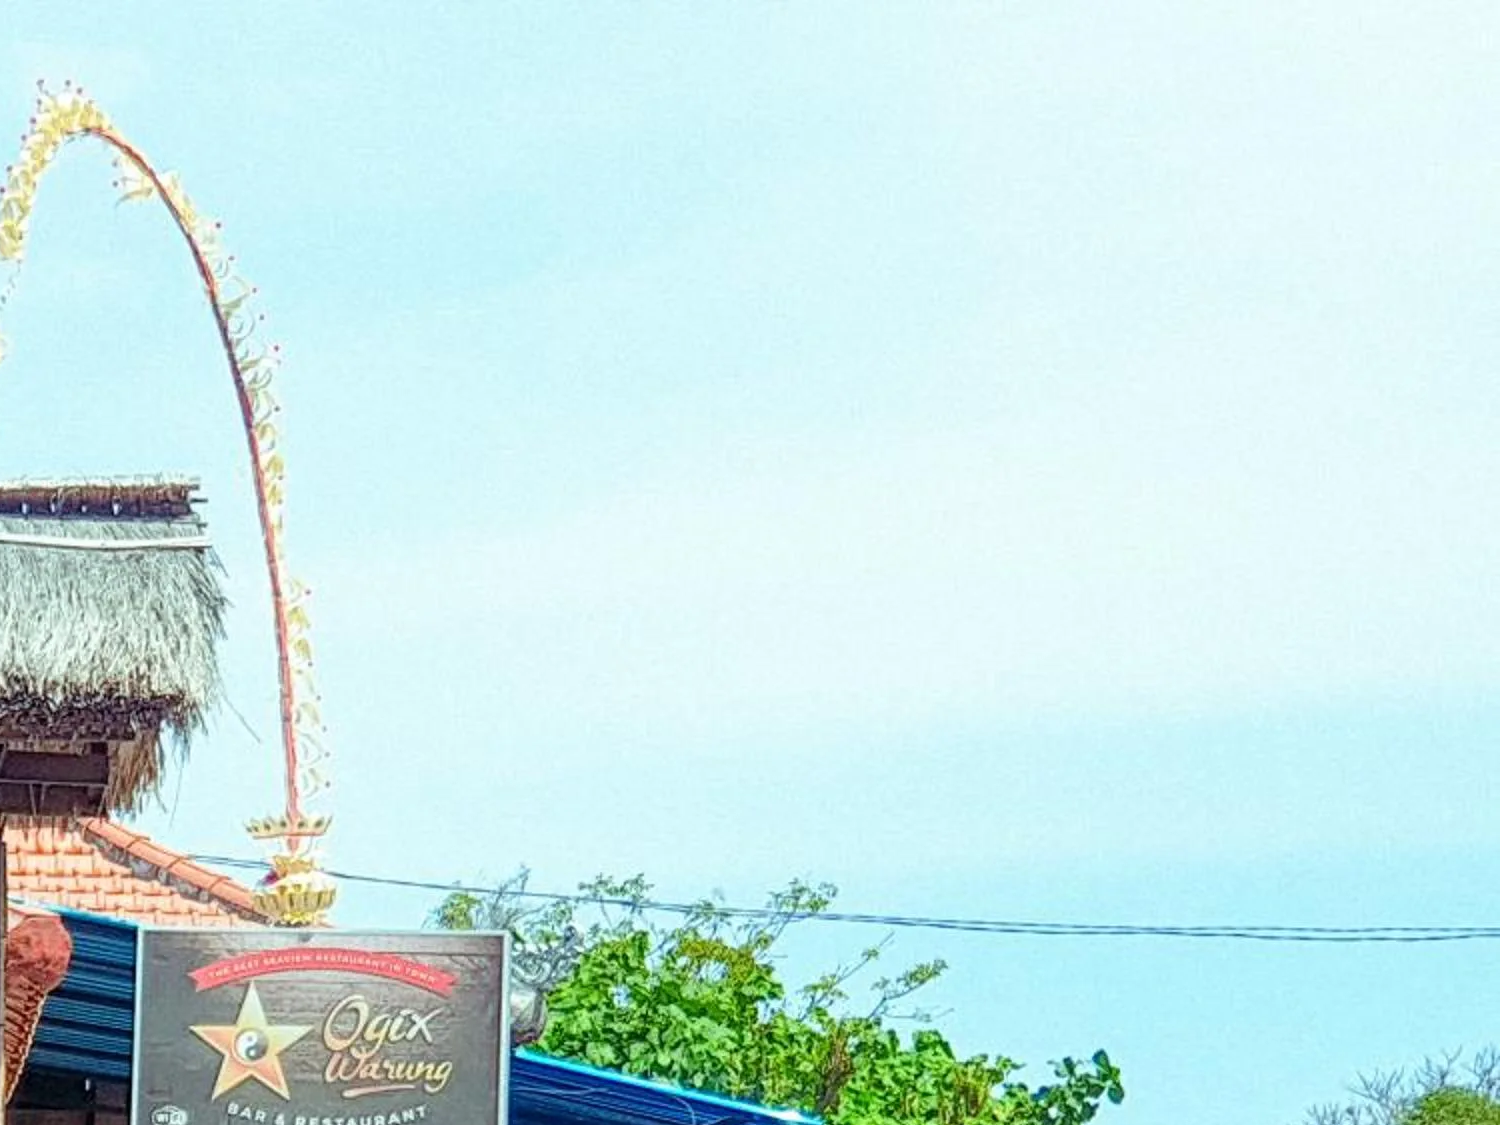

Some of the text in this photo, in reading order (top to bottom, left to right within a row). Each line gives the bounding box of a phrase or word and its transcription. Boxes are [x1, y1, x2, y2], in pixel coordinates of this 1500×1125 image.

[322, 994, 444, 1060] Ogix
[321, 1046, 453, 1093] Warung
[226, 1102, 267, 1124] BAR
